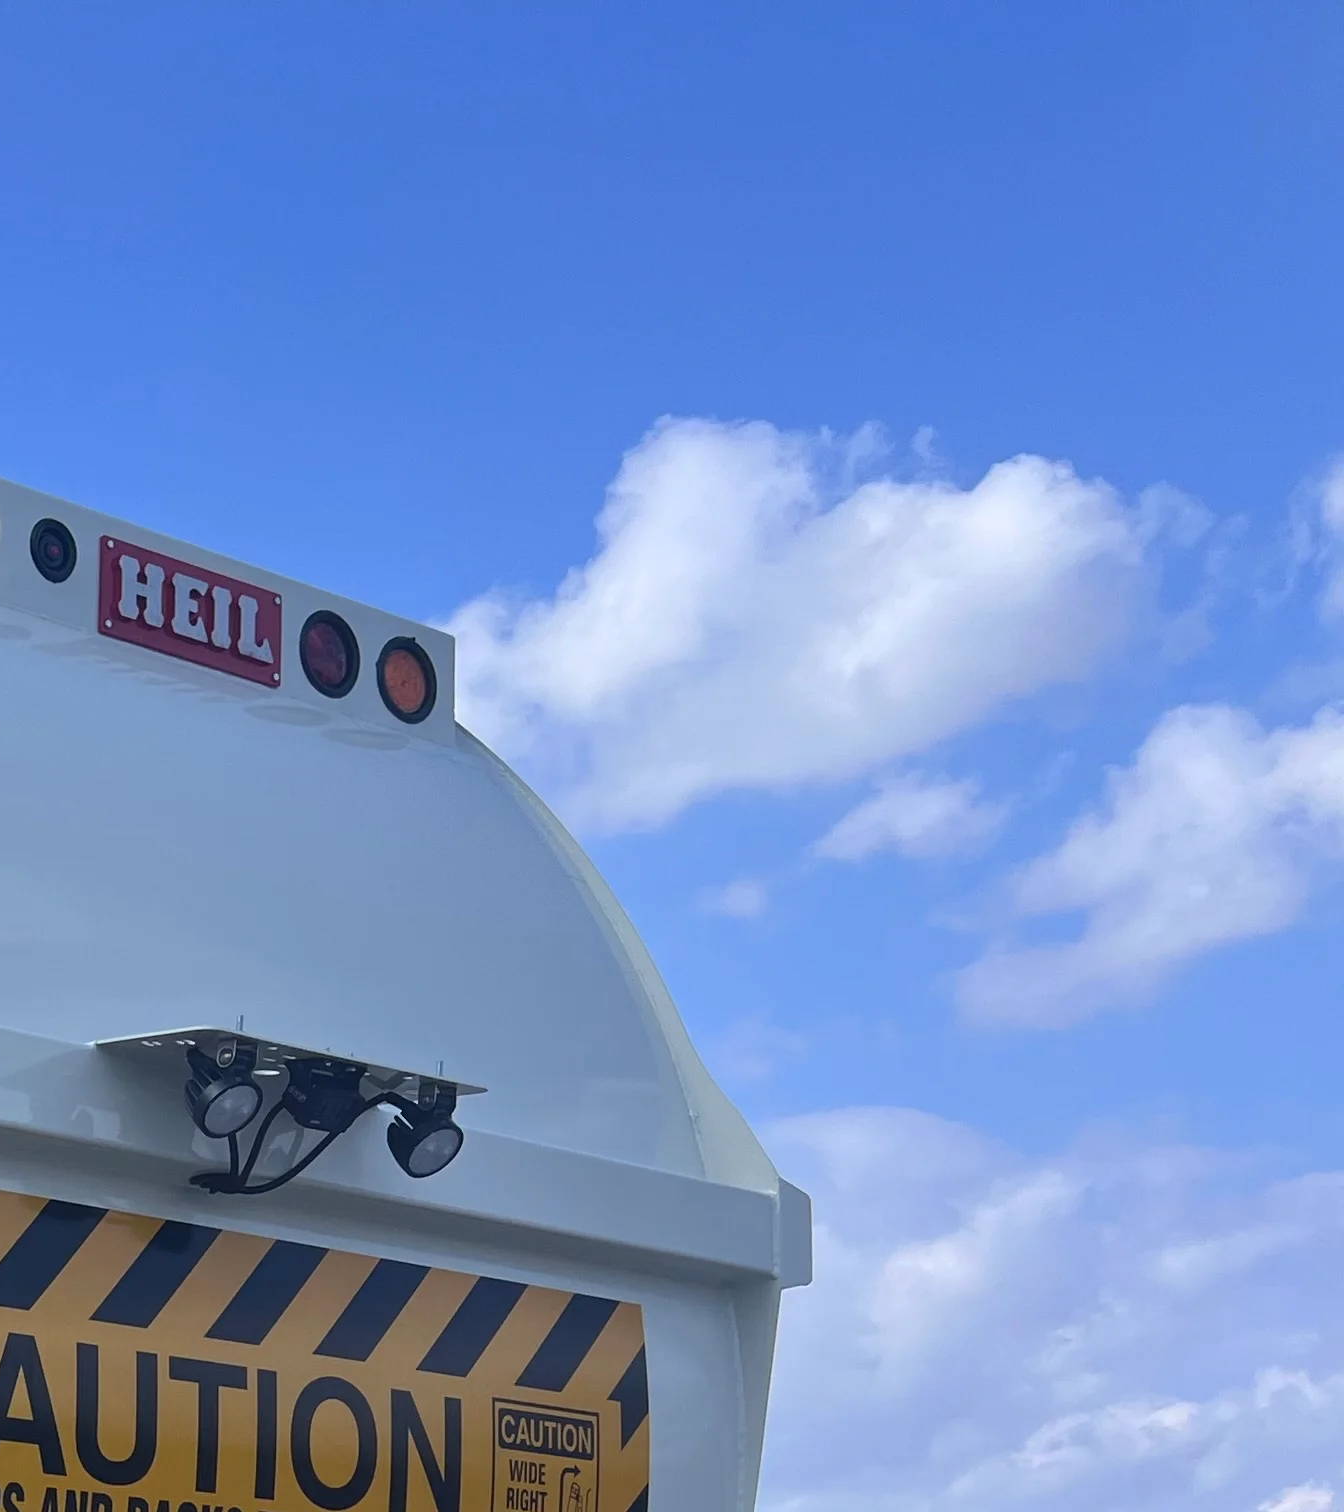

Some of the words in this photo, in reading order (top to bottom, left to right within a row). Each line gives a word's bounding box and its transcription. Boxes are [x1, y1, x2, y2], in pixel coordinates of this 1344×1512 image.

[118, 554, 274, 664] HEIL
[501, 1415, 592, 1454] CAUTION
[509, 1459, 546, 1486] WIDE
[506, 1487, 548, 1512] RIGHT
